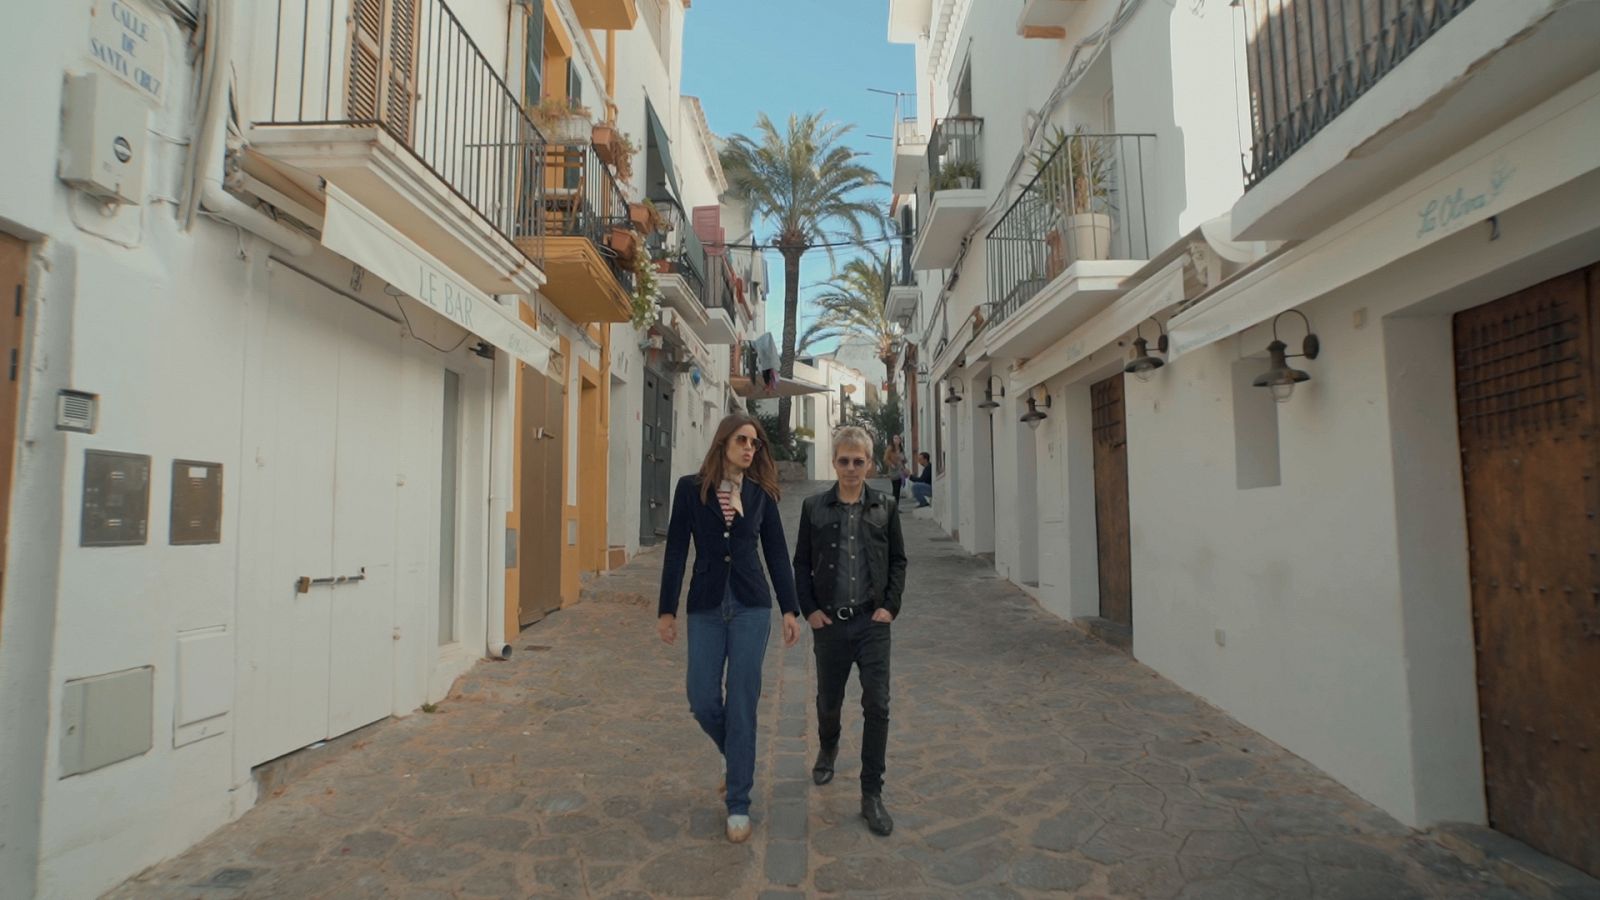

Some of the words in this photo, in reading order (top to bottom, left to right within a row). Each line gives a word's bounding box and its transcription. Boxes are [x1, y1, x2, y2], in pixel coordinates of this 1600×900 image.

[112, 1, 148, 41] CALLE
[121, 32, 137, 57] DE
[90, 38, 128, 76] SANTA
[134, 67, 161, 95] CRUZ
[419, 265, 438, 307] LE
[444, 283, 474, 329] BAR
